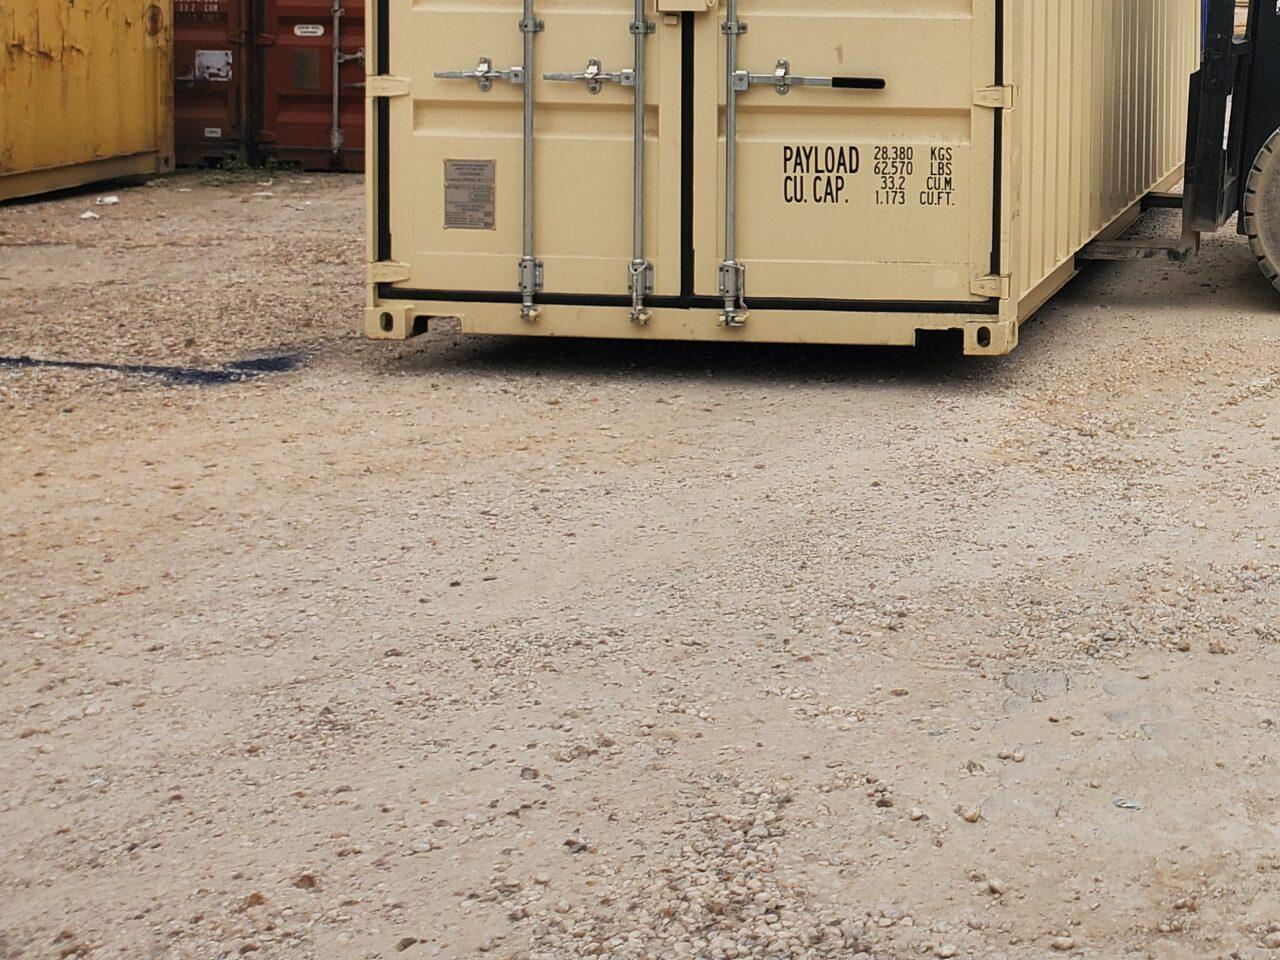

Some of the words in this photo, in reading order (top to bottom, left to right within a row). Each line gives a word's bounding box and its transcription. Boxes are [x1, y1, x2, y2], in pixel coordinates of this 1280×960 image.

[783, 145, 860, 174] PAYLOAD
[930, 147, 953, 161] KGS
[930, 162, 953, 176] LBS
[880, 176, 906, 190] 33.2
